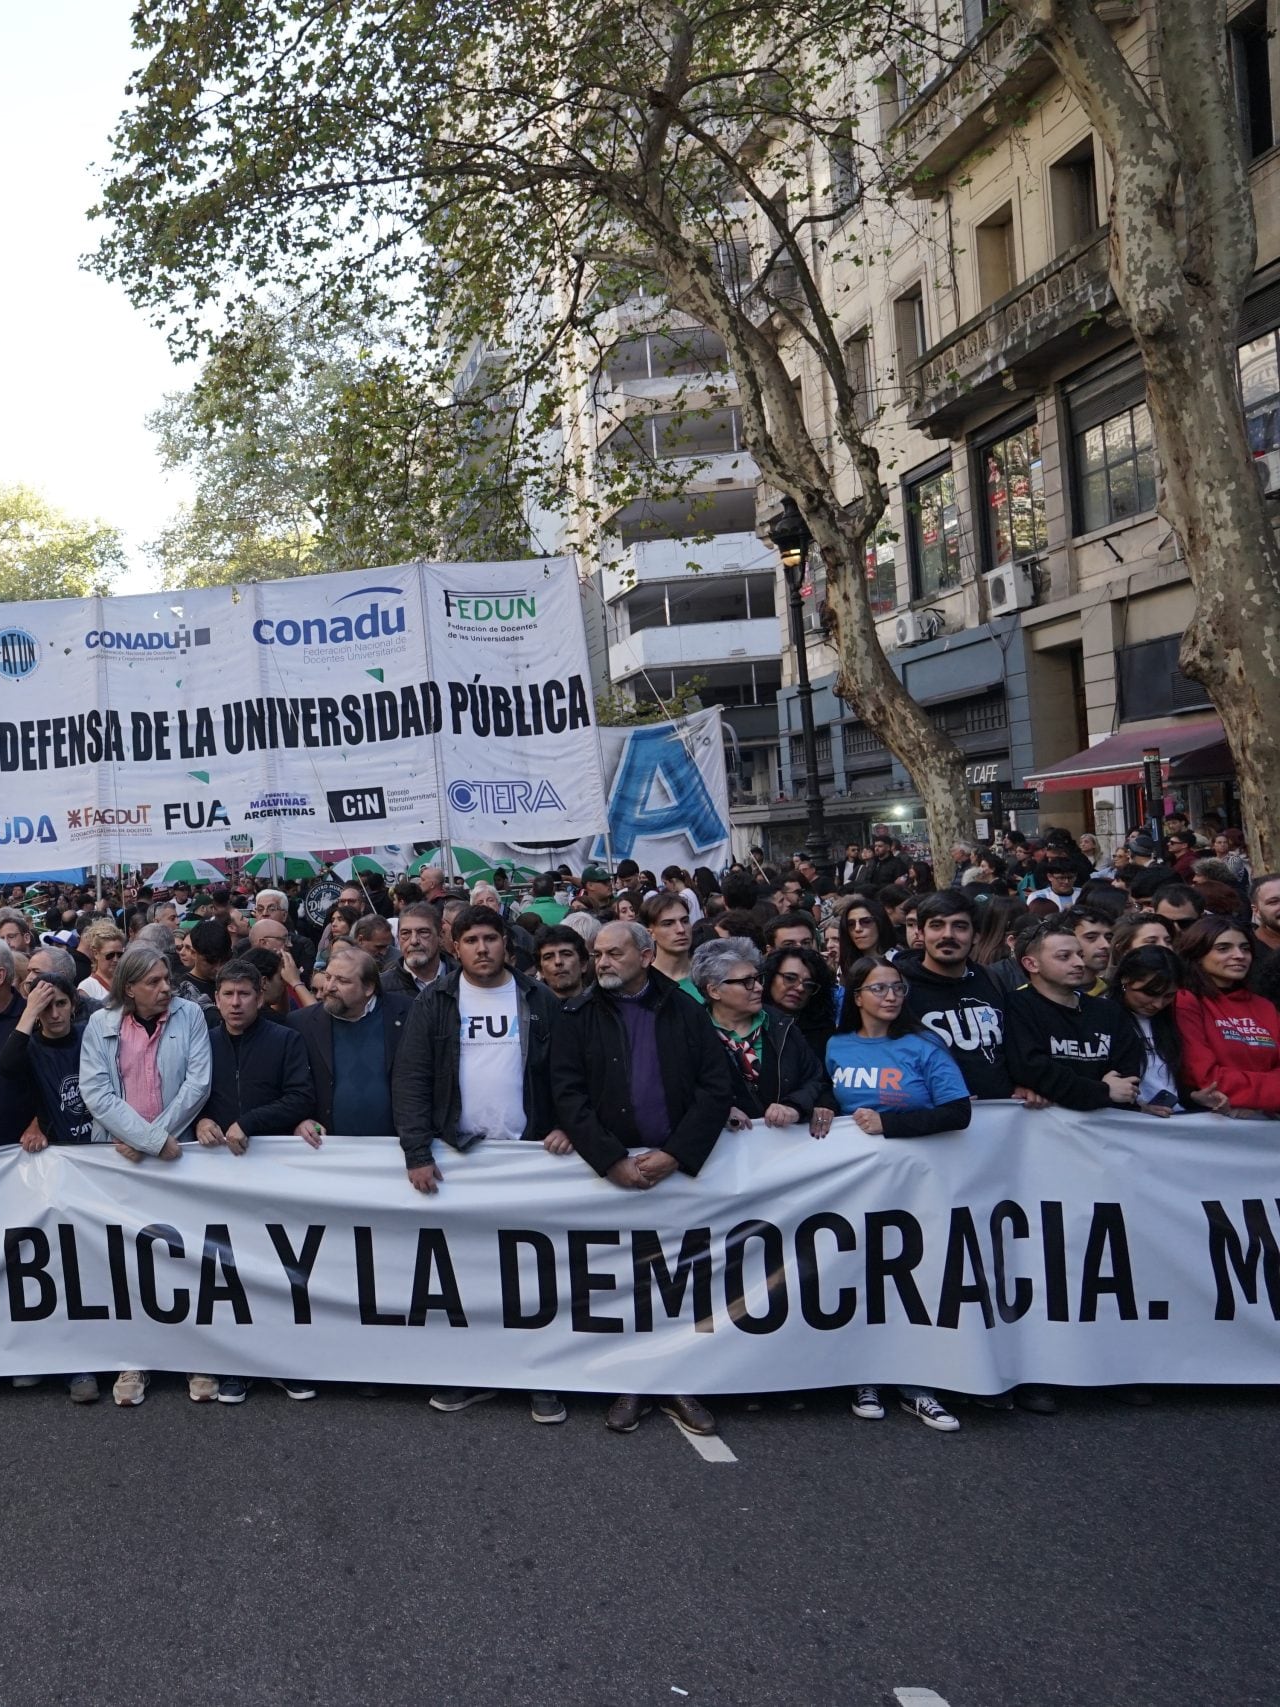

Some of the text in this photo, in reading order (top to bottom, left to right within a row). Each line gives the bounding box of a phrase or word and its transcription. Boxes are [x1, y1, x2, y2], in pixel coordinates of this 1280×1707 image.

[443, 590, 536, 621] FEDUN
[252, 603, 406, 646] conadu
[500, 624, 538, 632] Docentes
[303, 645, 407, 665] Docentes Universitarios
[355, 639, 393, 652] Nacional
[396, 636, 407, 644] de
[131, 711, 172, 762] DE
[178, 707, 217, 759] LA
[222, 681, 443, 754] UNIVERSIDAD
[448, 674, 590, 737] PÚBLICA
[973, 764, 998, 784] CAFE
[250, 798, 307, 809] MALVINAS
[387, 788, 410, 797] Consejo
[388, 792, 437, 803] Interuniversitario
[448, 779, 567, 814] CTERA
[84, 804, 152, 828] FAGDUT
[163, 799, 232, 831] FUA
[244, 808, 316, 820] ARGENTINAS
[342, 793, 380, 817] CiN
[389, 803, 414, 811] Nacional
[921, 1005, 1003, 1051] SUR
[832, 1066, 903, 1091] MNR
[265, 1224, 325, 1325] Y
[353, 1226, 469, 1328] LA
[497, 1199, 1170, 1336] DEMOCRACIA.
[1201, 1198, 1280, 1322] M
